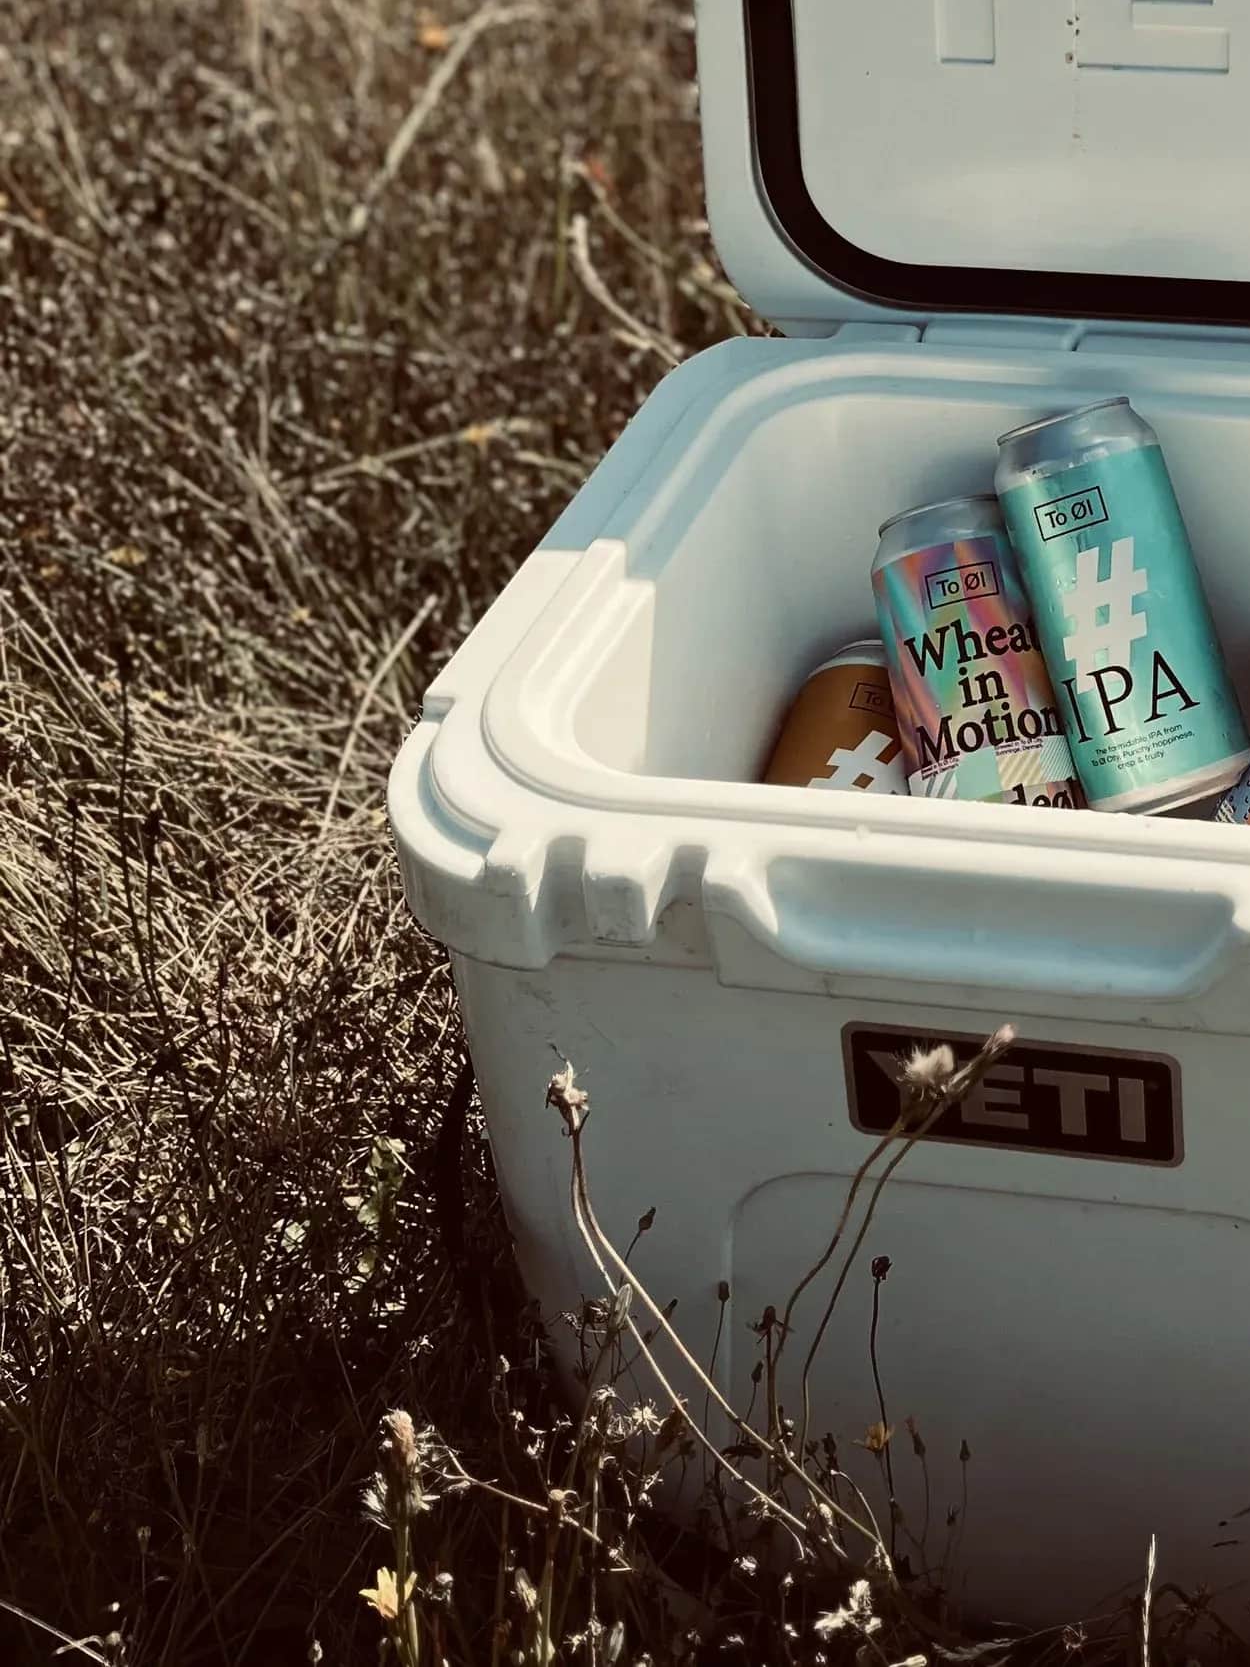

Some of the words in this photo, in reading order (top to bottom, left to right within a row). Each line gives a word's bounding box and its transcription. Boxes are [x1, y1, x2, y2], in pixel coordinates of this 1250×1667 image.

[1044, 509, 1067, 529] To
[1071, 499, 1094, 521] Øl
[936, 580, 960, 597] To
[964, 571, 987, 591] Øl
[904, 619, 1041, 677] Wheat
[958, 666, 1009, 708] in
[1061, 650, 1200, 744] IPA
[916, 701, 1062, 768] Motion
[1148, 729, 1163, 741] IPA
[1163, 724, 1183, 733] from
